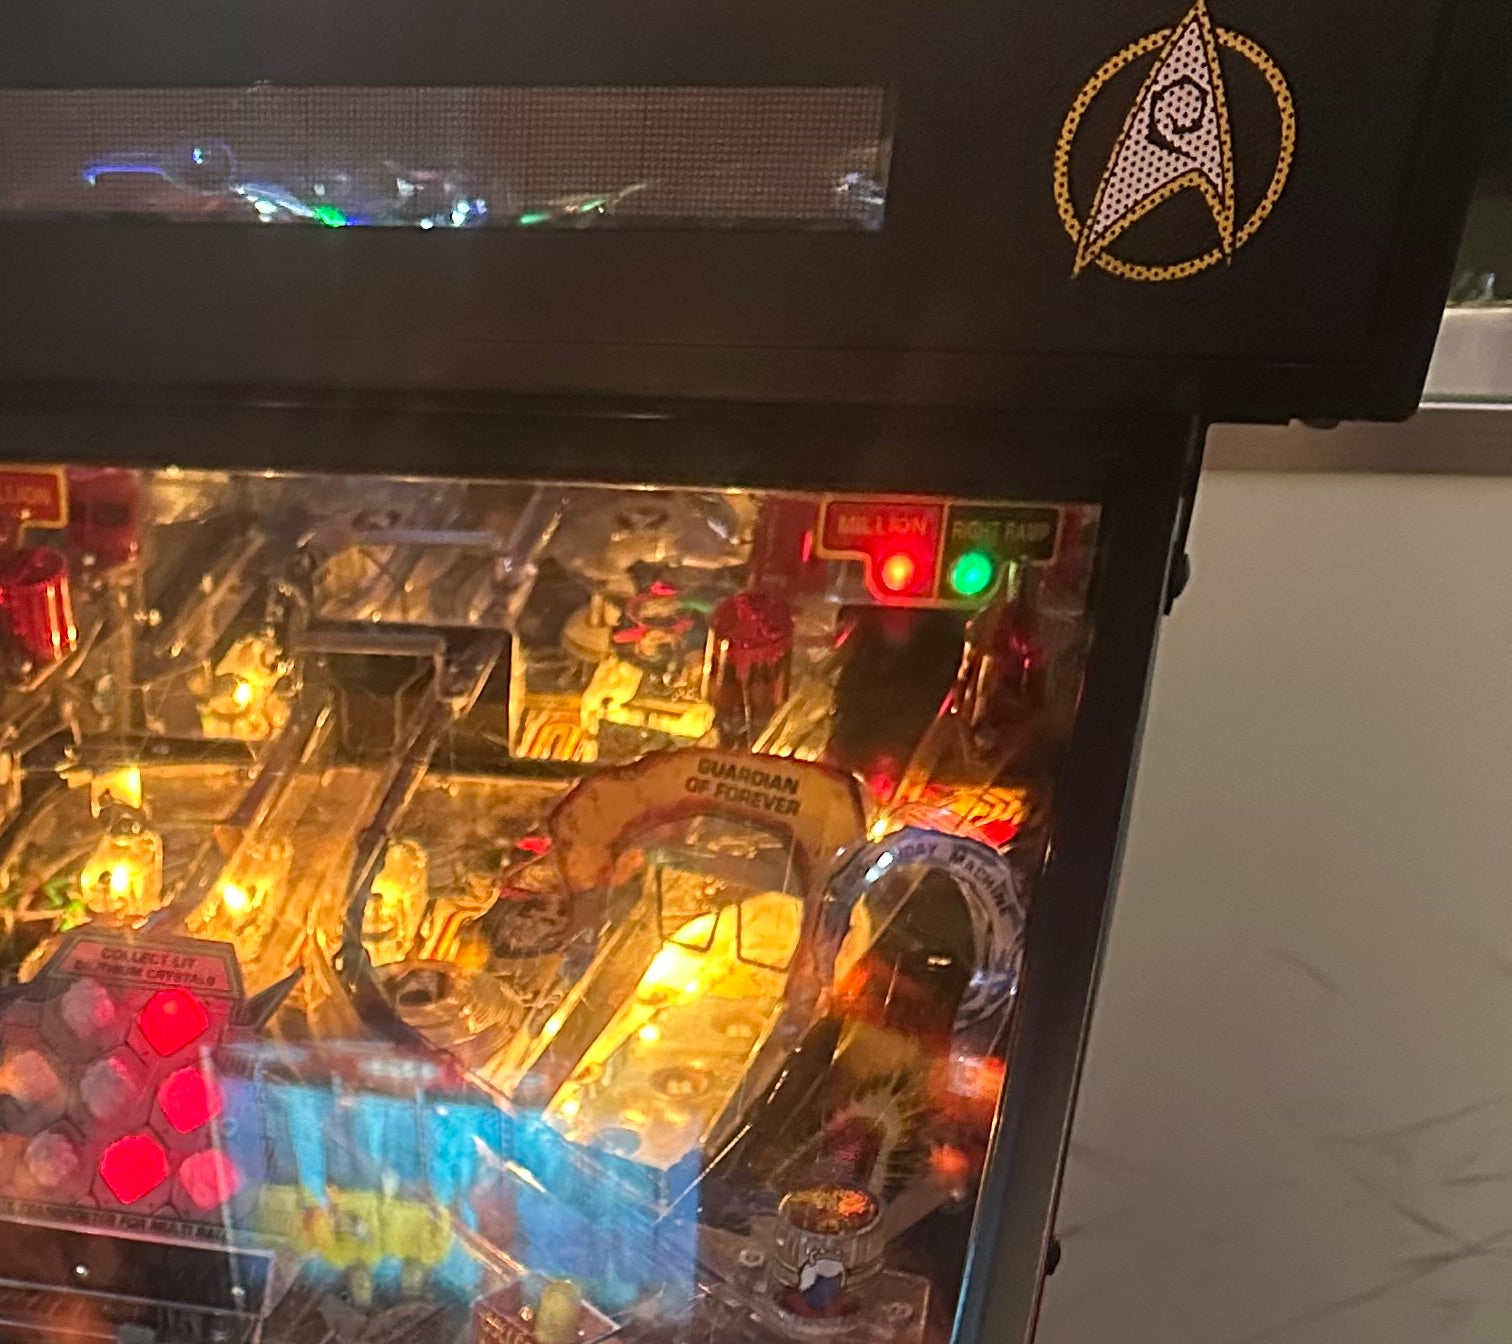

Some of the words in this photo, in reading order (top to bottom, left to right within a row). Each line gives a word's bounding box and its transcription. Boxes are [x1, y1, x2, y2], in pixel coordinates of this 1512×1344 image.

[837, 511, 929, 536] MILLION
[698, 758, 799, 794] GUARDIAN
[685, 776, 711, 793] OF
[714, 783, 801, 816] FOREVER
[101, 946, 168, 966] COLLECT
